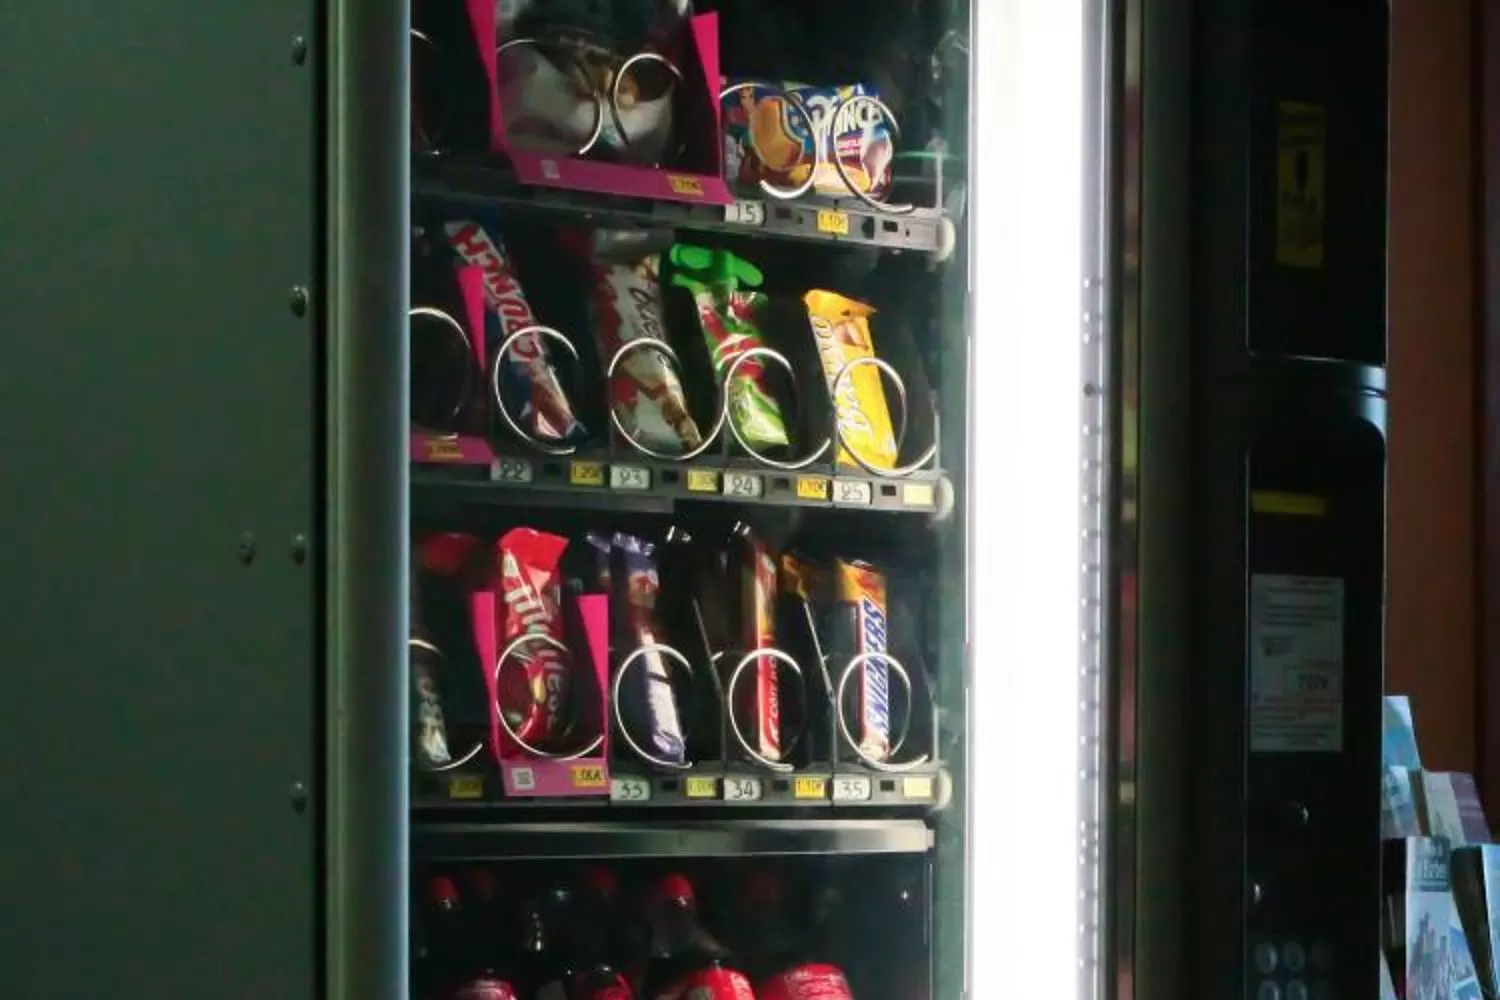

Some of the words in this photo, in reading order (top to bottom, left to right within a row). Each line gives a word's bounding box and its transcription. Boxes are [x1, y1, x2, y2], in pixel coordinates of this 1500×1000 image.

[737, 201, 757, 222] 15
[448, 222, 541, 362] CRUNCH
[863, 598, 889, 738] SNICKERS
[734, 781, 755, 797] 34
[842, 781, 864, 797] 35
